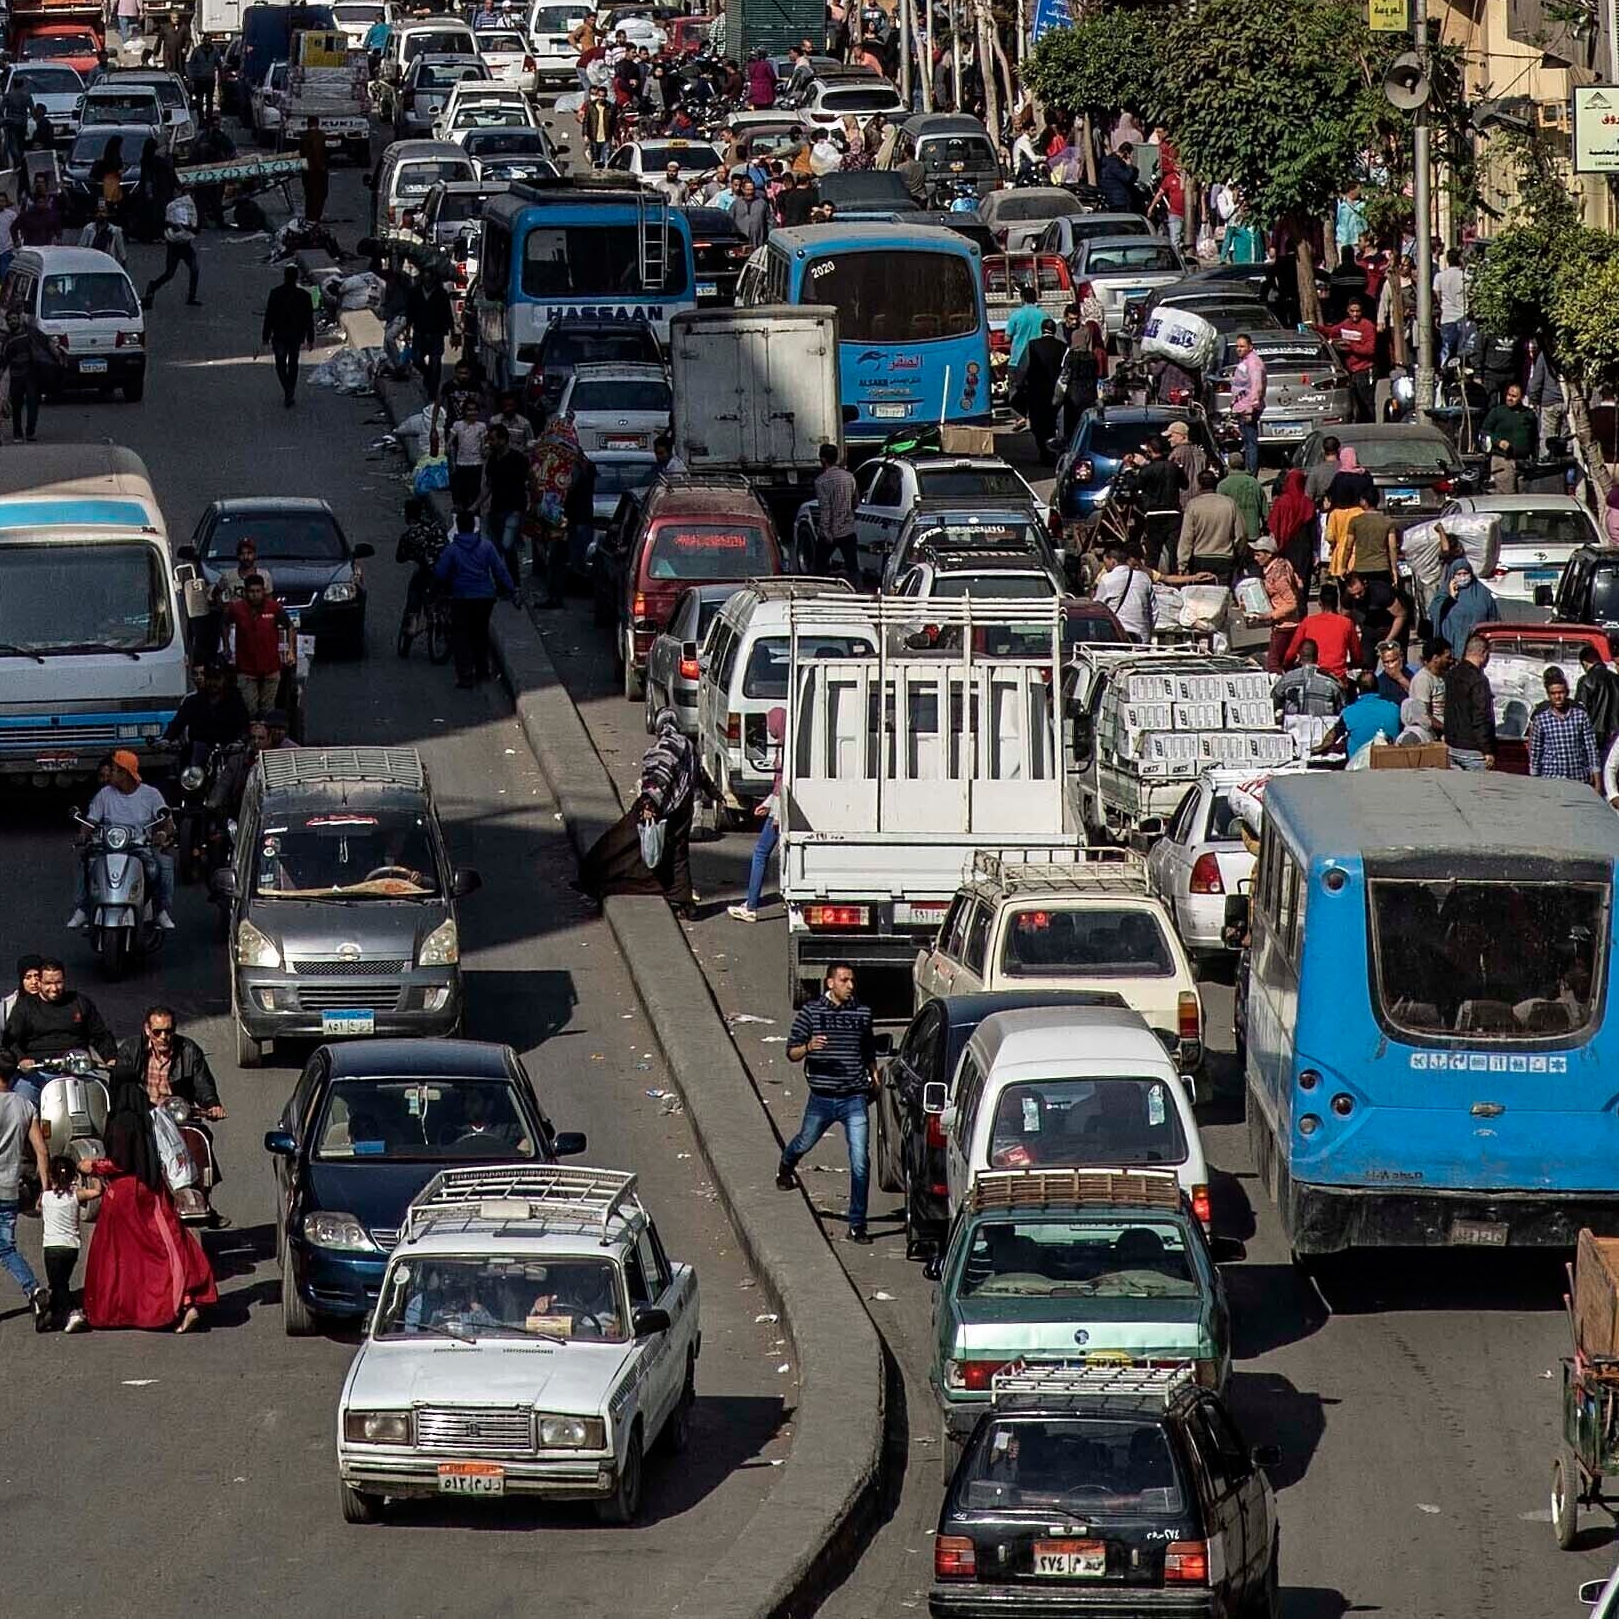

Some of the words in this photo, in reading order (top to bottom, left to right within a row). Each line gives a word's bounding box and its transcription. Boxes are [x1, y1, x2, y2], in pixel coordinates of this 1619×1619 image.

[811, 260, 835, 279] 2020
[547, 306, 663, 322] HASSAAN
[1040, 1556, 1064, 1571] ٢٧٤
